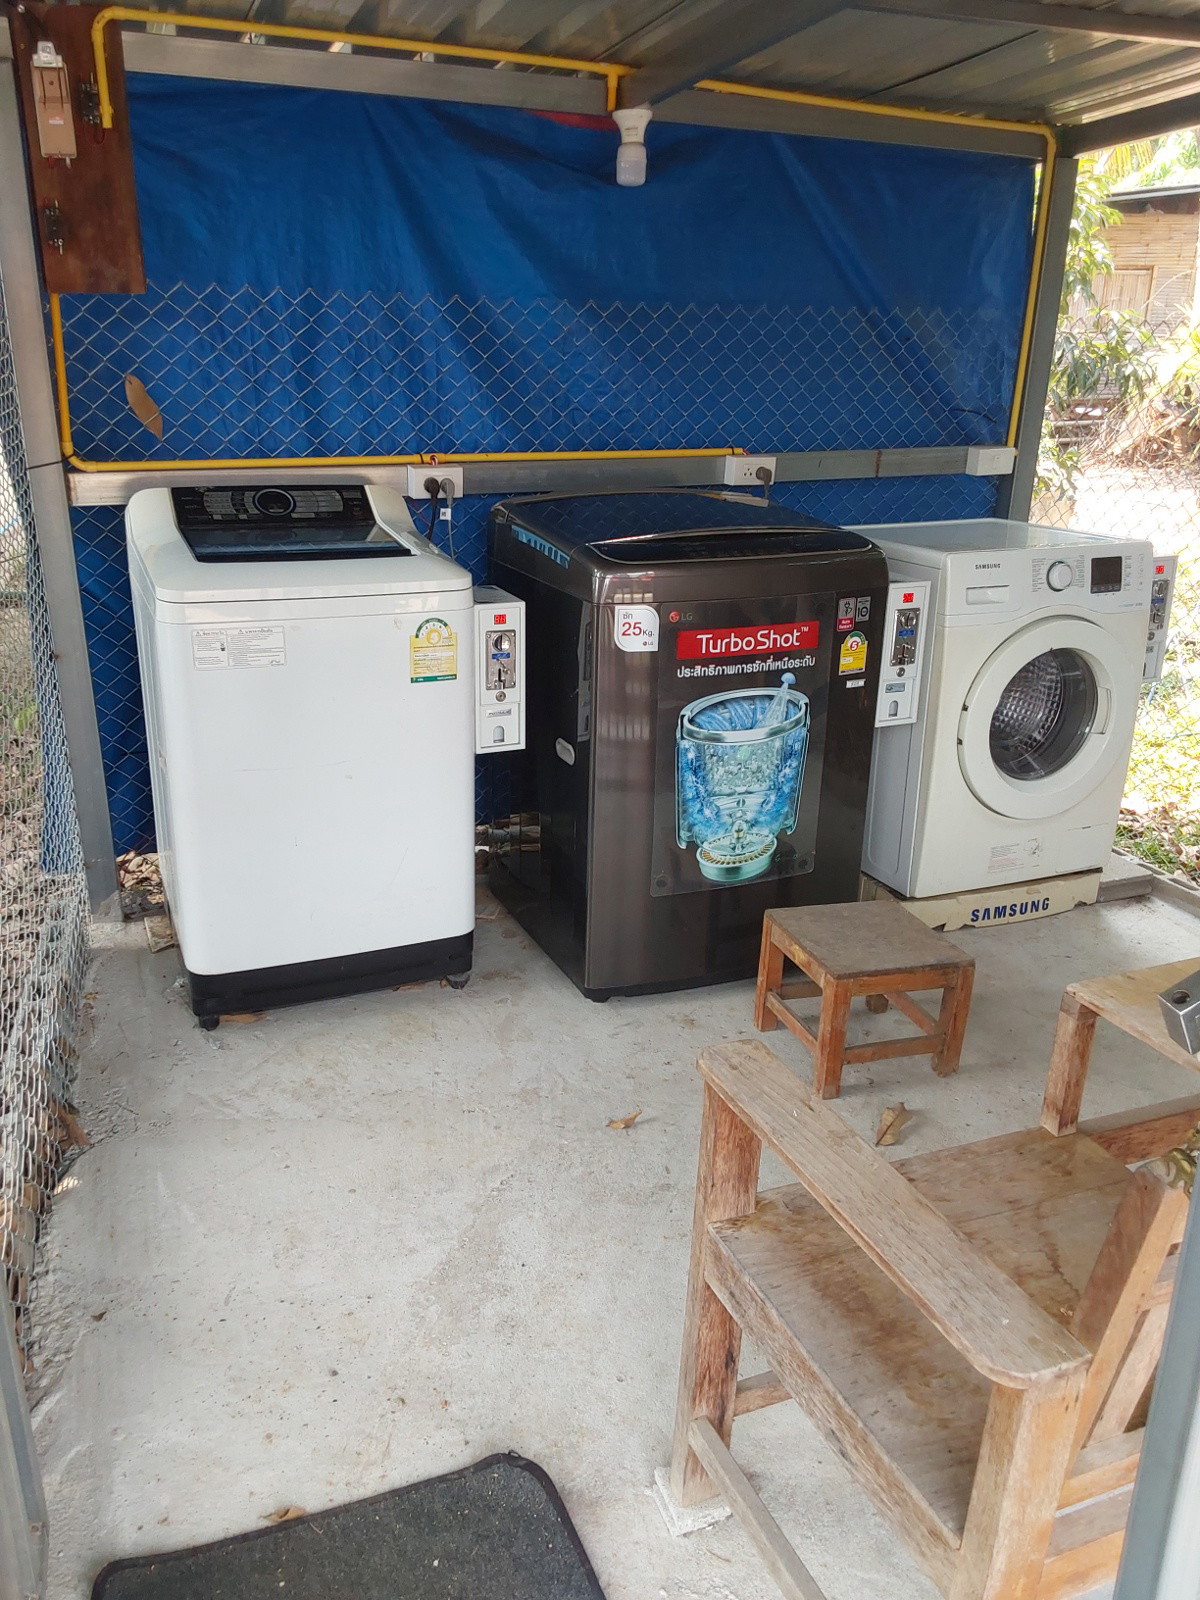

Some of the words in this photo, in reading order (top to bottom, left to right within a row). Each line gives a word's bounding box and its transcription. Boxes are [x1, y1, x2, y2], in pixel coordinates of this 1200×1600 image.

[677, 655, 816, 678] ประสิทธิภาพการซักที่เหนือระดับ
[970, 897, 1050, 922] SAMSUNG
